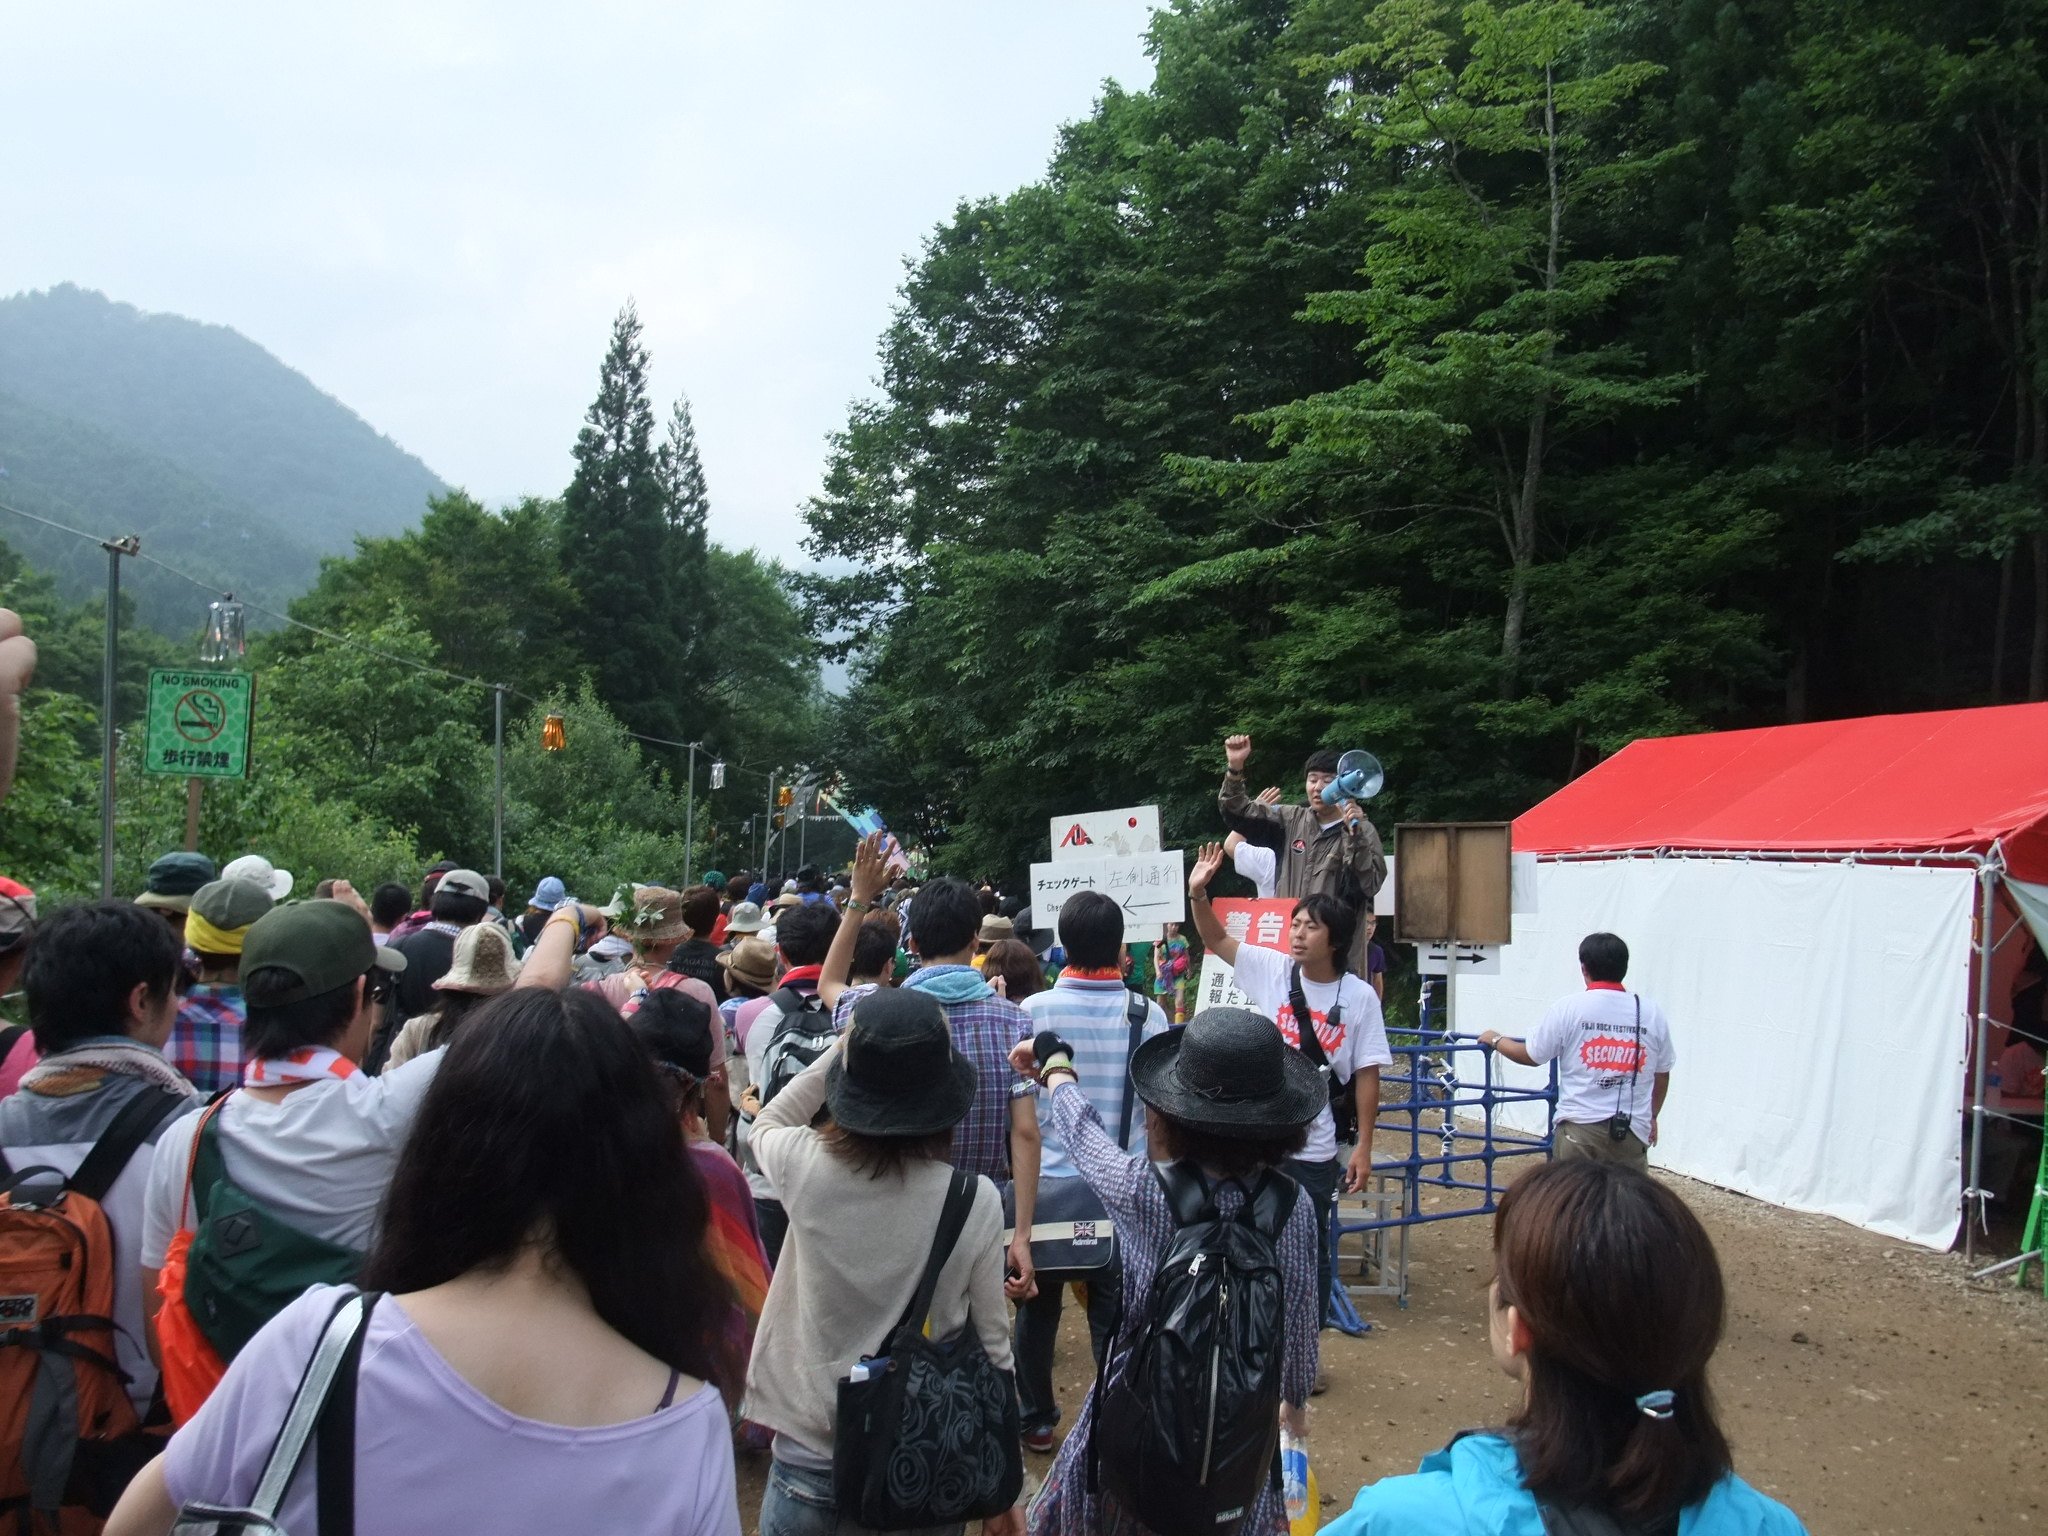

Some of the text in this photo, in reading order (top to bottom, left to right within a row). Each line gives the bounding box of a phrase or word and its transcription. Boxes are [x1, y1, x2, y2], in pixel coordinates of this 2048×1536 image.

[162, 675, 239, 688] NO SMOKING
[163, 749, 230, 768] 歩行禁煙
[1037, 875, 1096, 891] チェックゲート
[1108, 864, 1181, 889] 左側通行
[1224, 911, 1285, 944] 警告
[1581, 1022, 1595, 1031] FUJI
[1596, 1022, 1611, 1032] ROCK
[1072, 1238, 1098, 1246] Admiral
